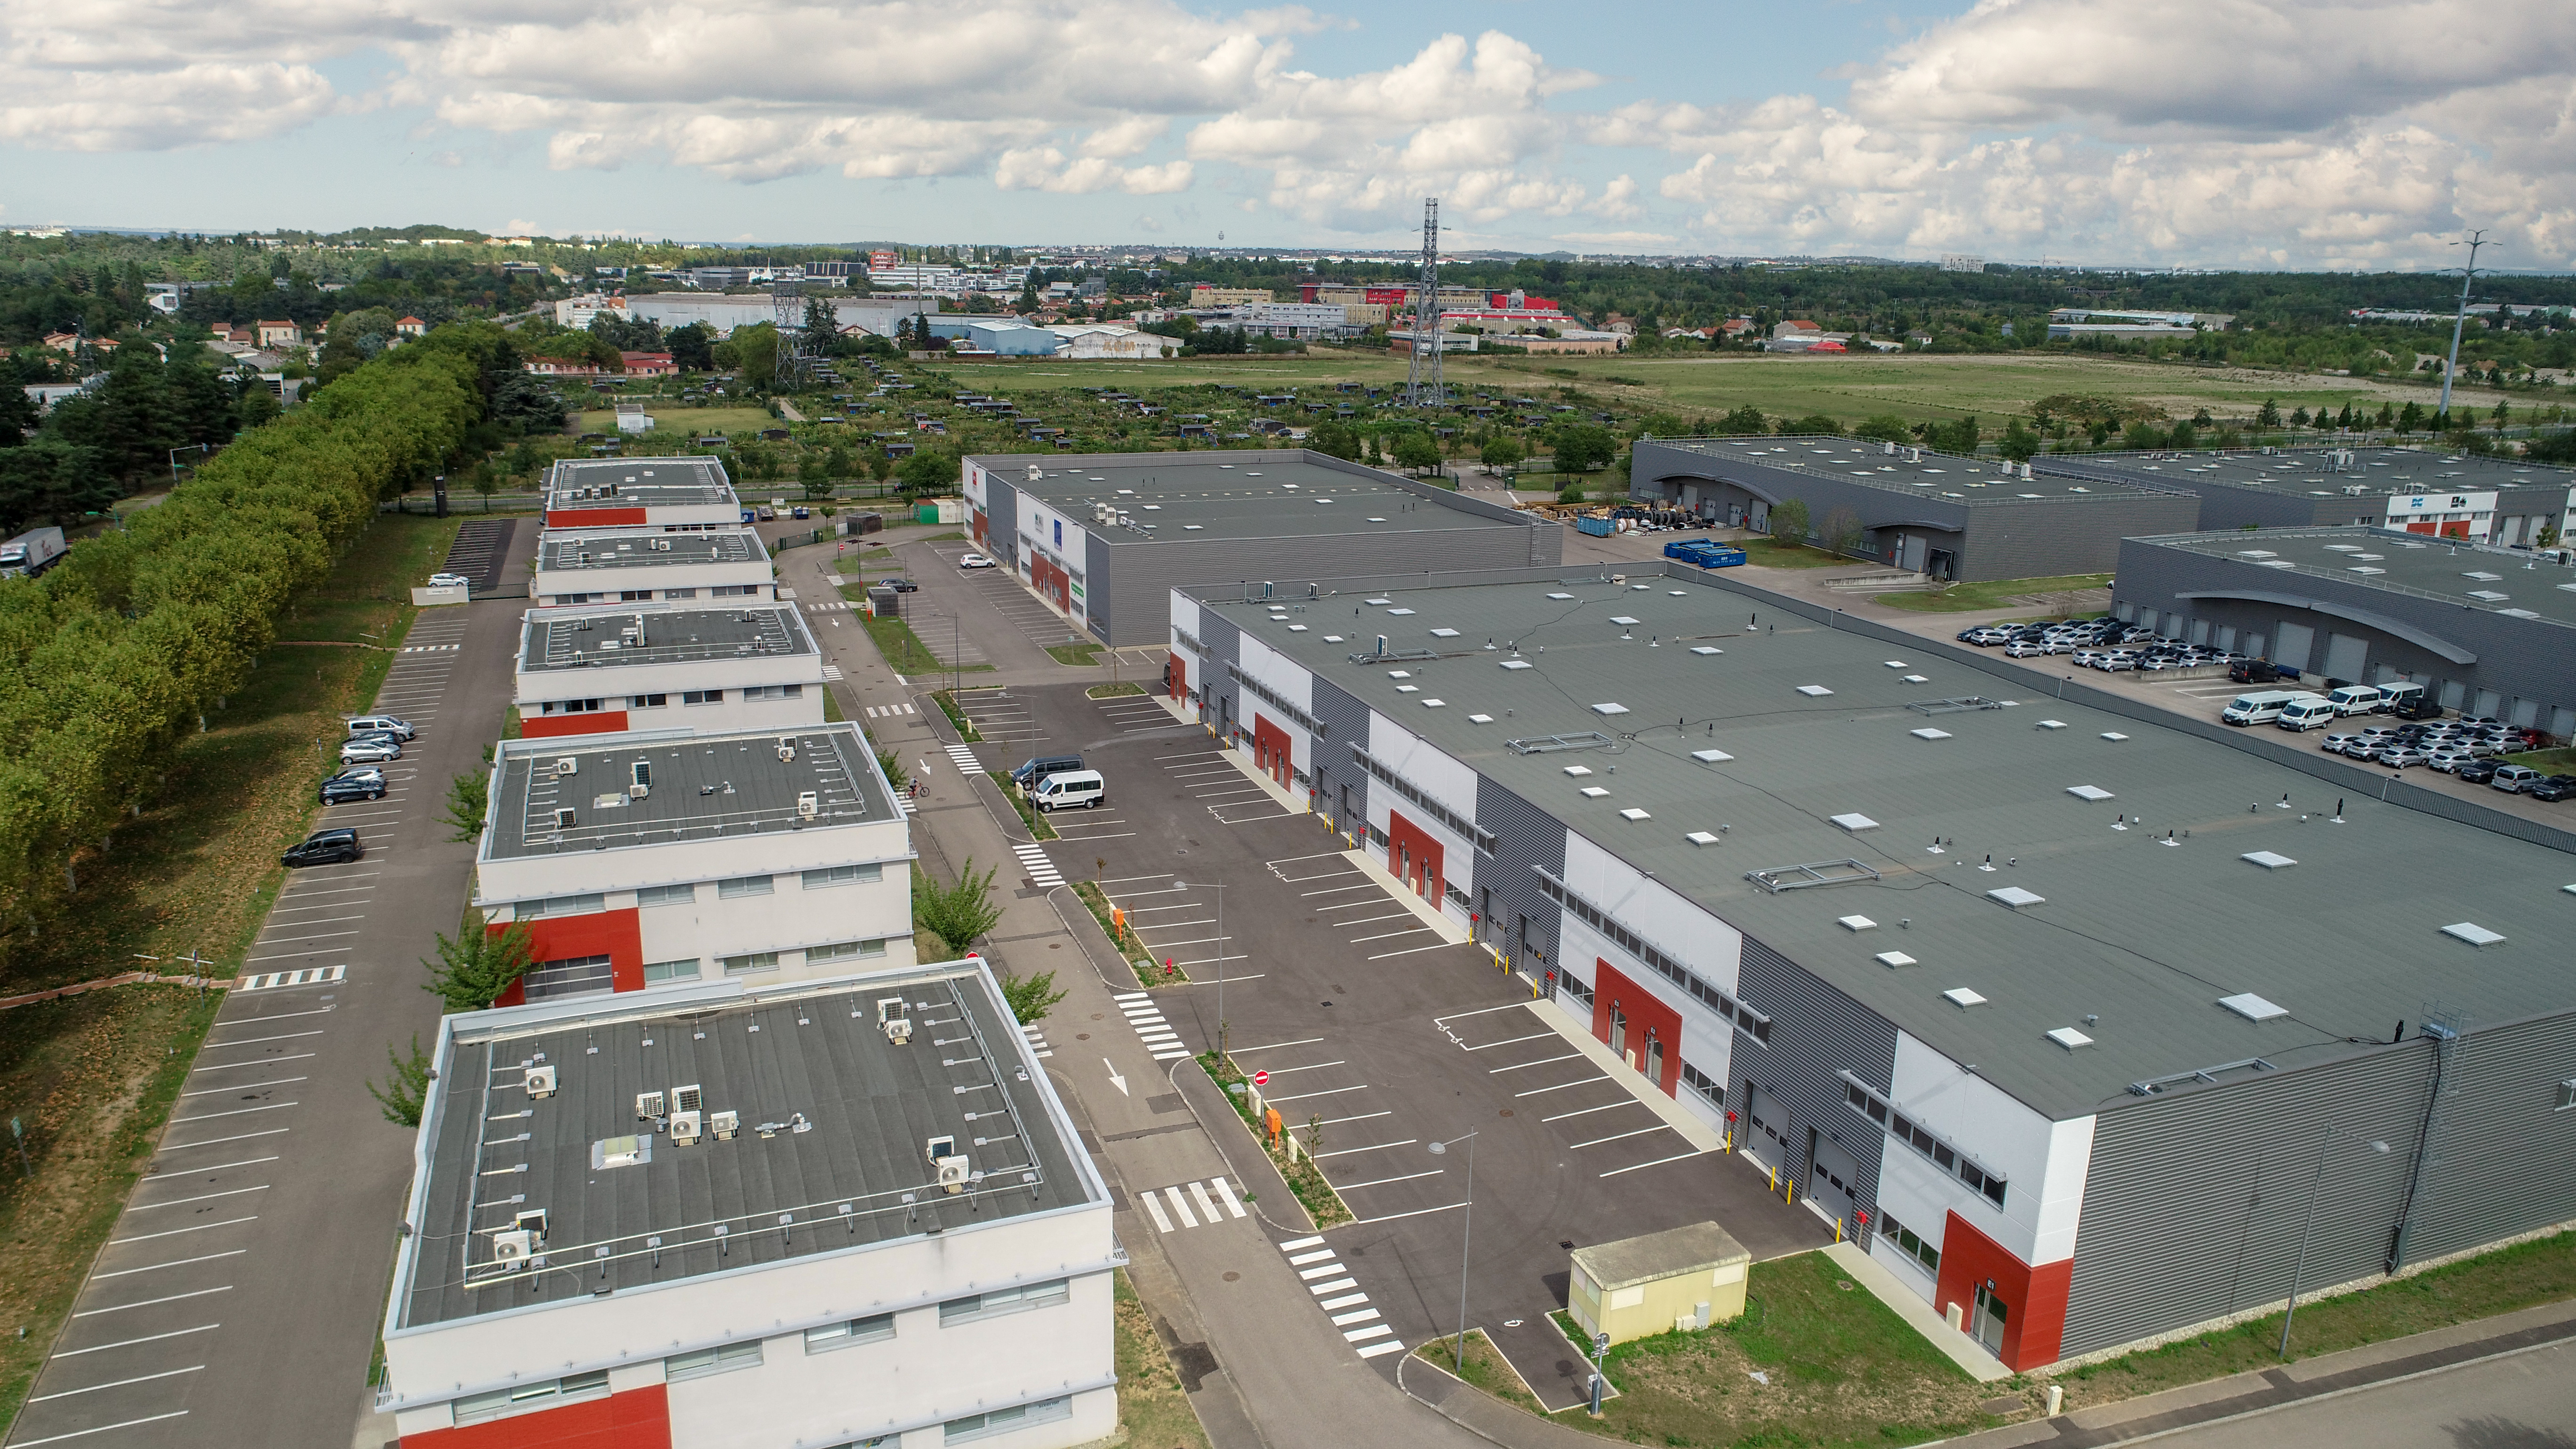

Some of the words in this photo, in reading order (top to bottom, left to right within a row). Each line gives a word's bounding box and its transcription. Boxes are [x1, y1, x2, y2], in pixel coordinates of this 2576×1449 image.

[1650, 1026, 1656, 1034] E2
[1988, 1279, 1994, 1289] E1
[1038, 1401, 1060, 1409] sixense
